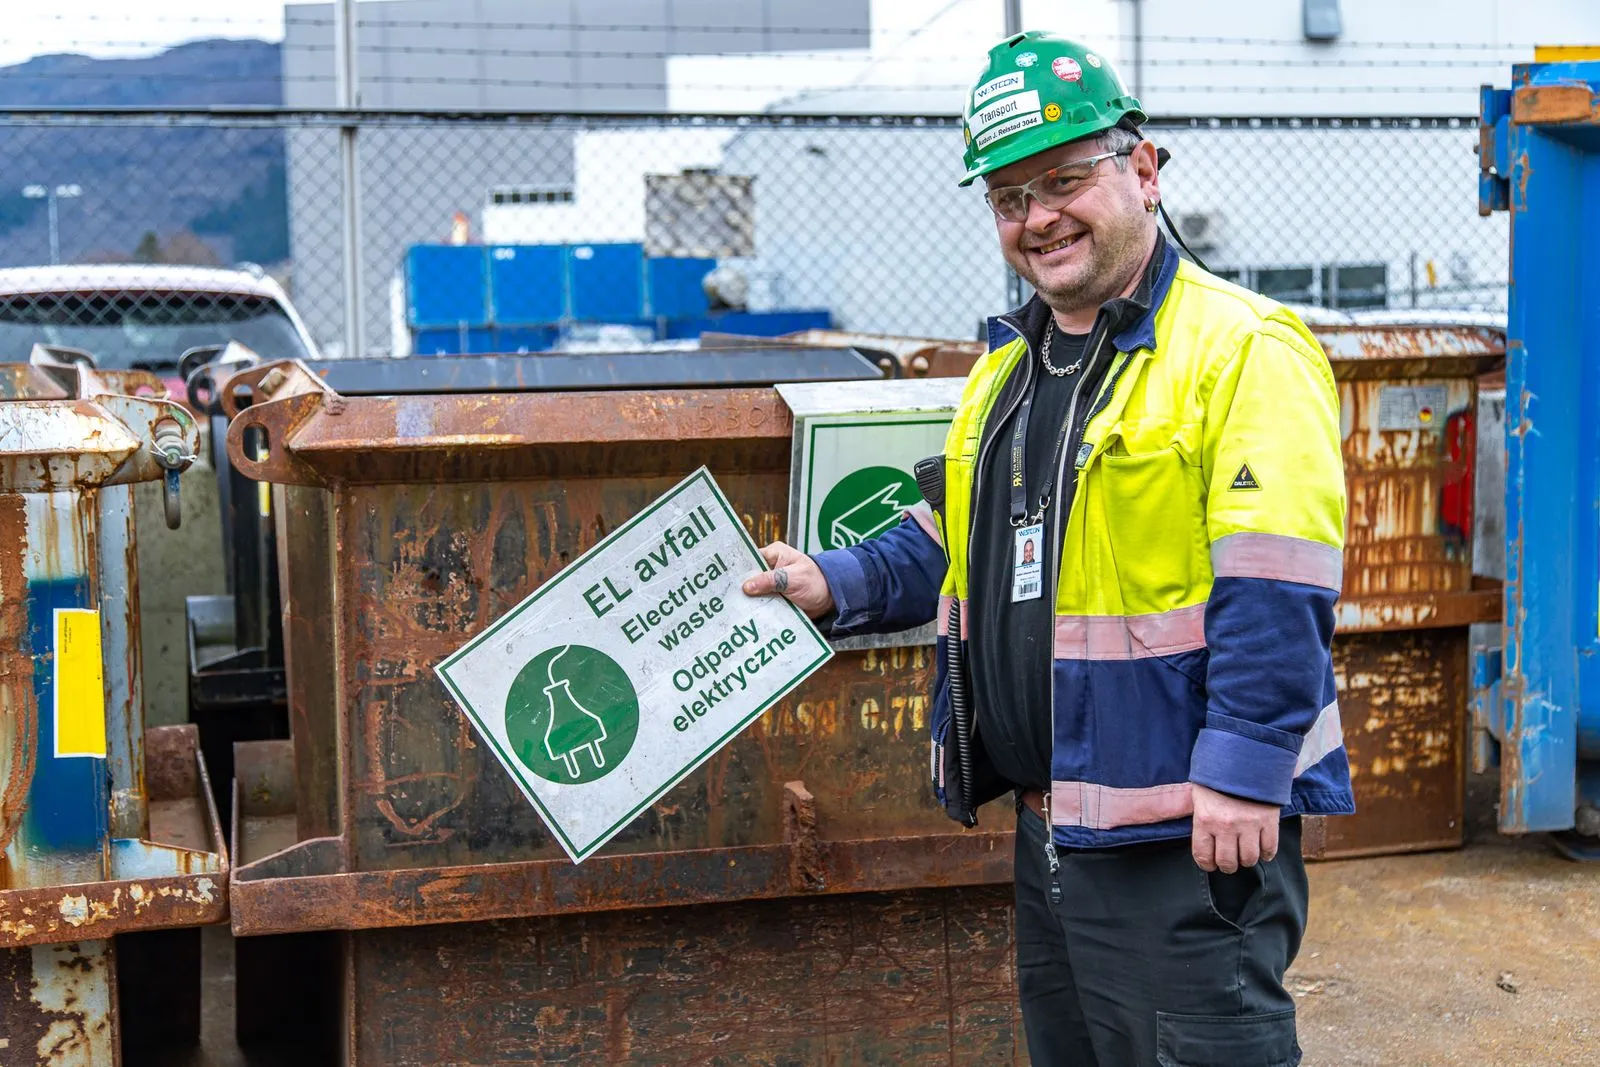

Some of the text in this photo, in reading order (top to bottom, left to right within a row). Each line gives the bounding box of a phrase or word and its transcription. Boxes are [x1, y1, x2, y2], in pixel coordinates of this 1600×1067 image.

[980, 100, 1018, 124] Transport
[998, 123, 1021, 136] Reistad
[1022, 117, 1038, 127] 3044
[582, 575, 633, 619] EL
[634, 505, 717, 583] avfall
[620, 553, 728, 644] Electrical
[657, 596, 725, 652] waste
[672, 618, 761, 692] Odpady
[672, 628, 797, 732] elektryczne
